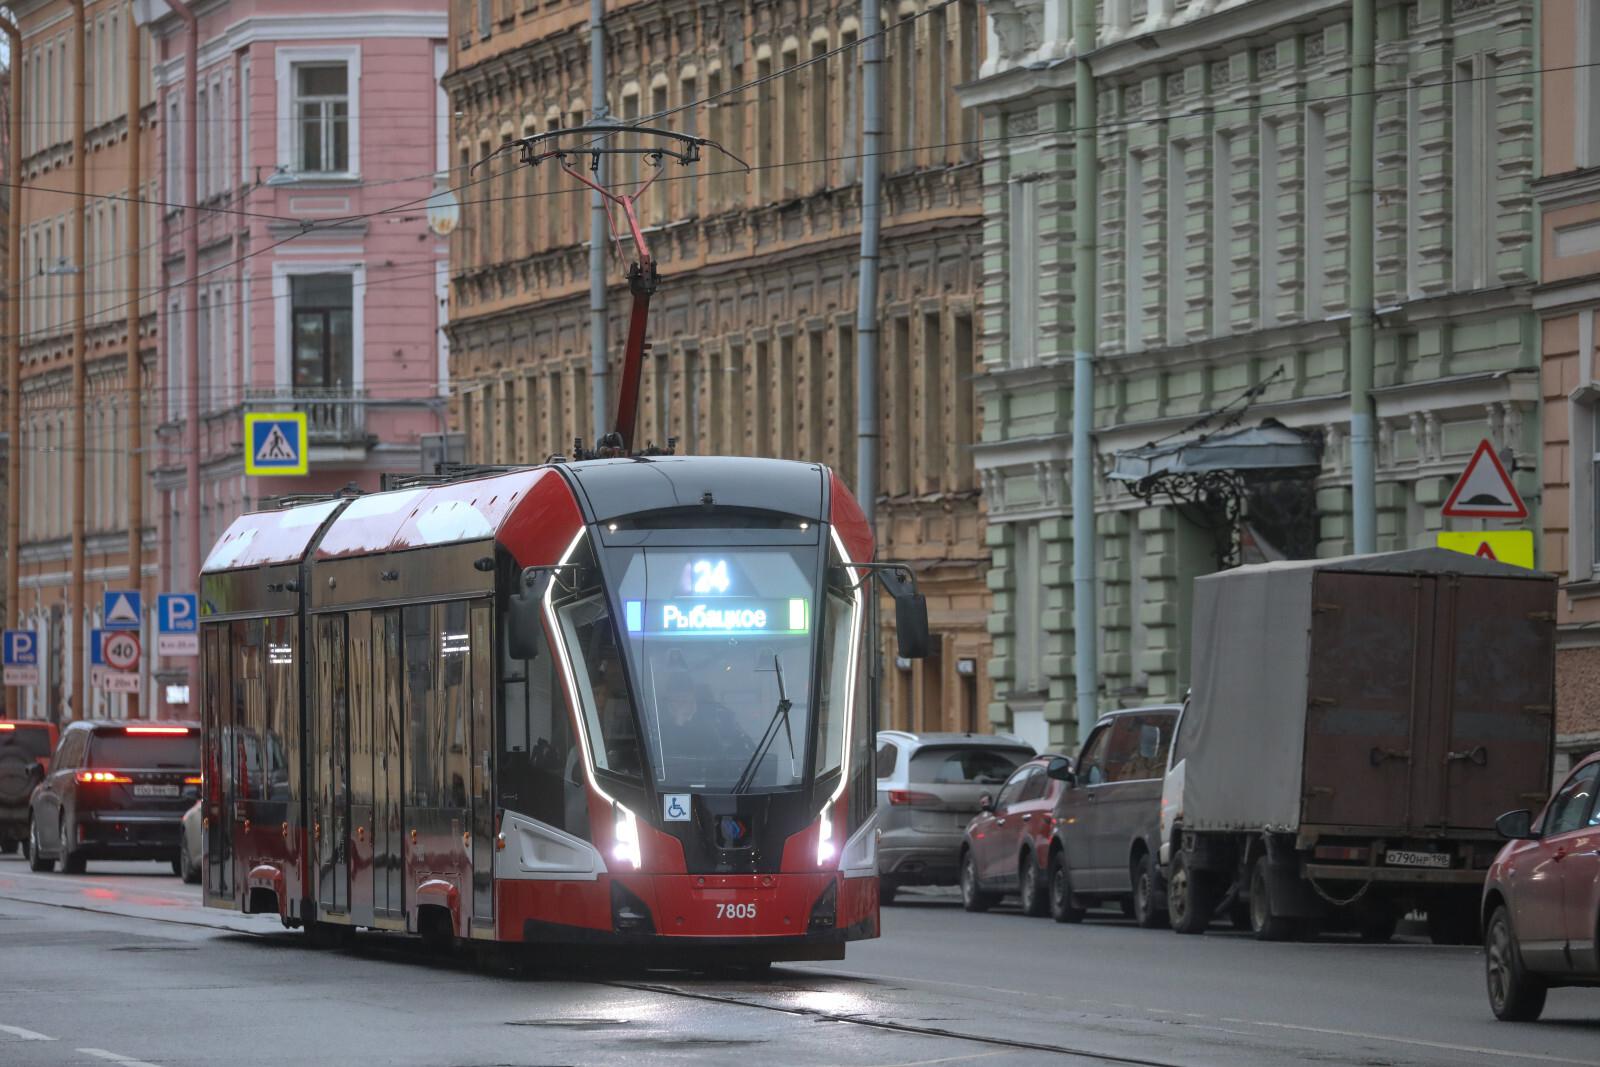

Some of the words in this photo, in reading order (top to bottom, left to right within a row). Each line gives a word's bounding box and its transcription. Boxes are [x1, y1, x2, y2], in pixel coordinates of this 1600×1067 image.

[693, 559, 730, 593] 24
[168, 597, 190, 630] P
[662, 603, 767, 630] Рыбацкое
[13, 634, 32, 662] P
[111, 643, 134, 659] 40
[716, 903, 756, 919] 7805
